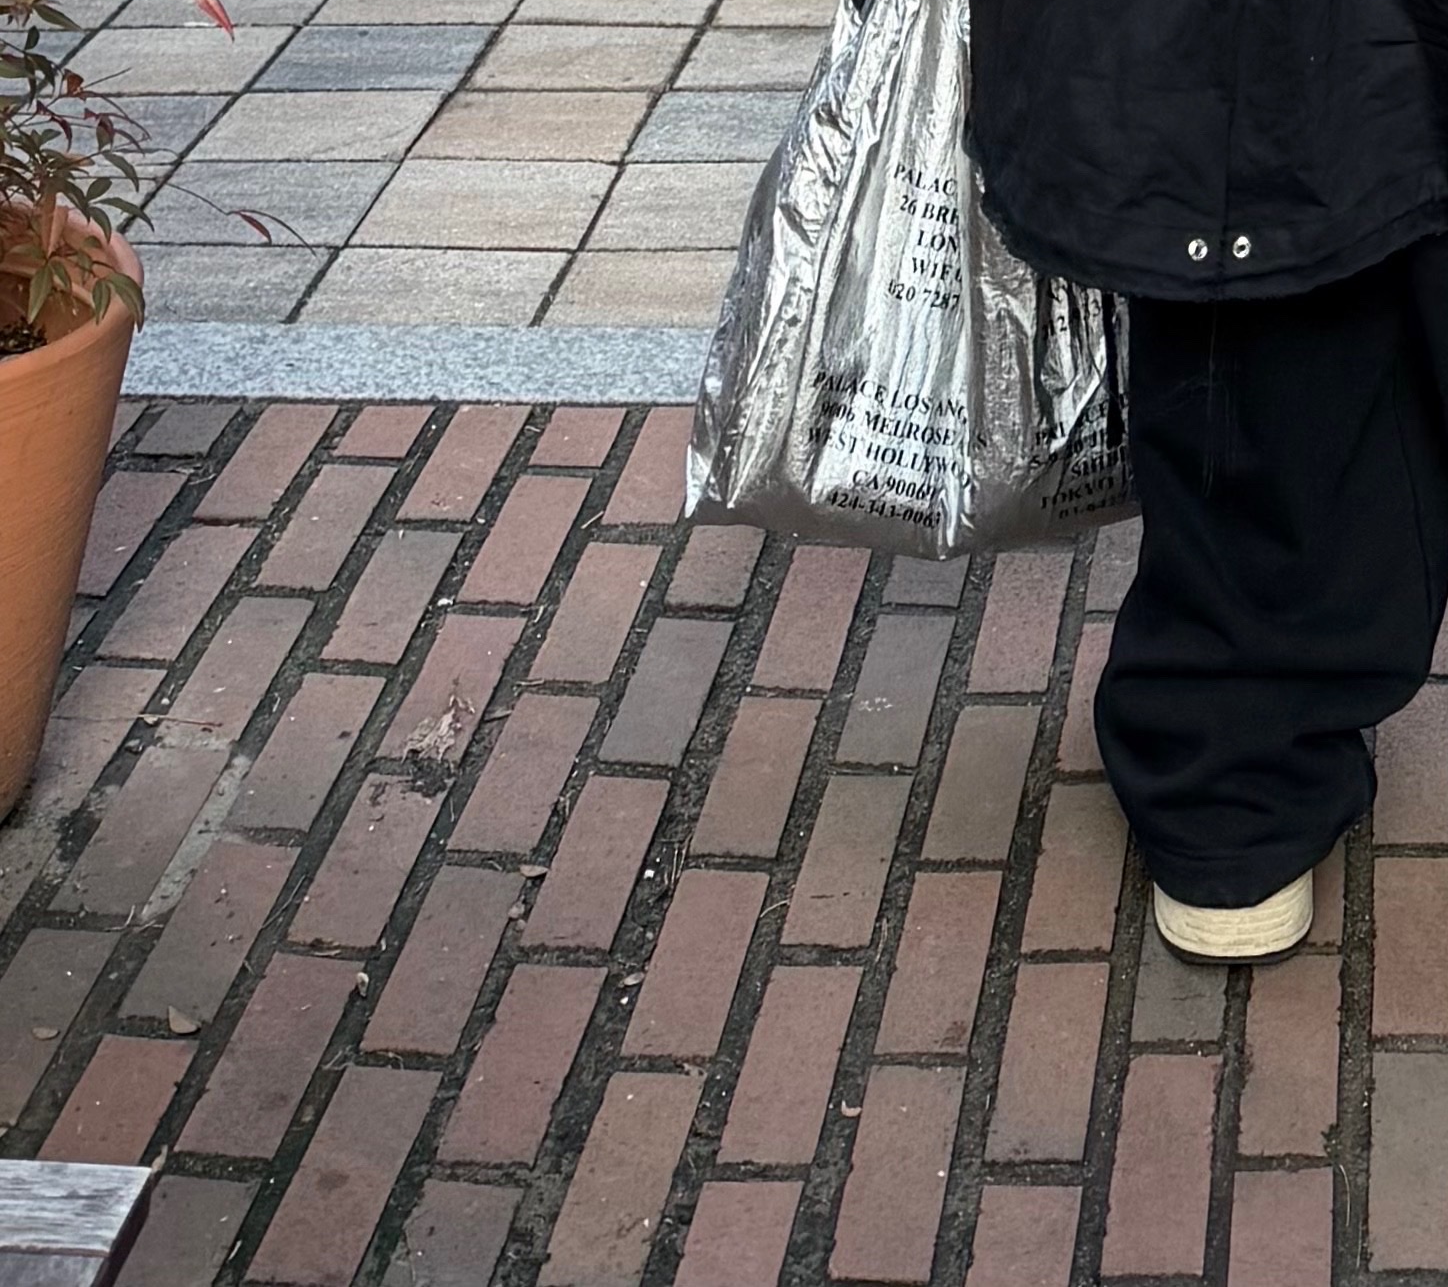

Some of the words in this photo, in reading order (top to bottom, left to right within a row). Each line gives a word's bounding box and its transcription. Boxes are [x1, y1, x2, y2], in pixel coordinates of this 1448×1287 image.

[900, 194, 917, 216] 26
[813, 371, 888, 404] PALACE
[891, 388, 932, 415] LOS
[865, 410, 956, 446] MELROSE
[852, 469, 879, 490] CA
